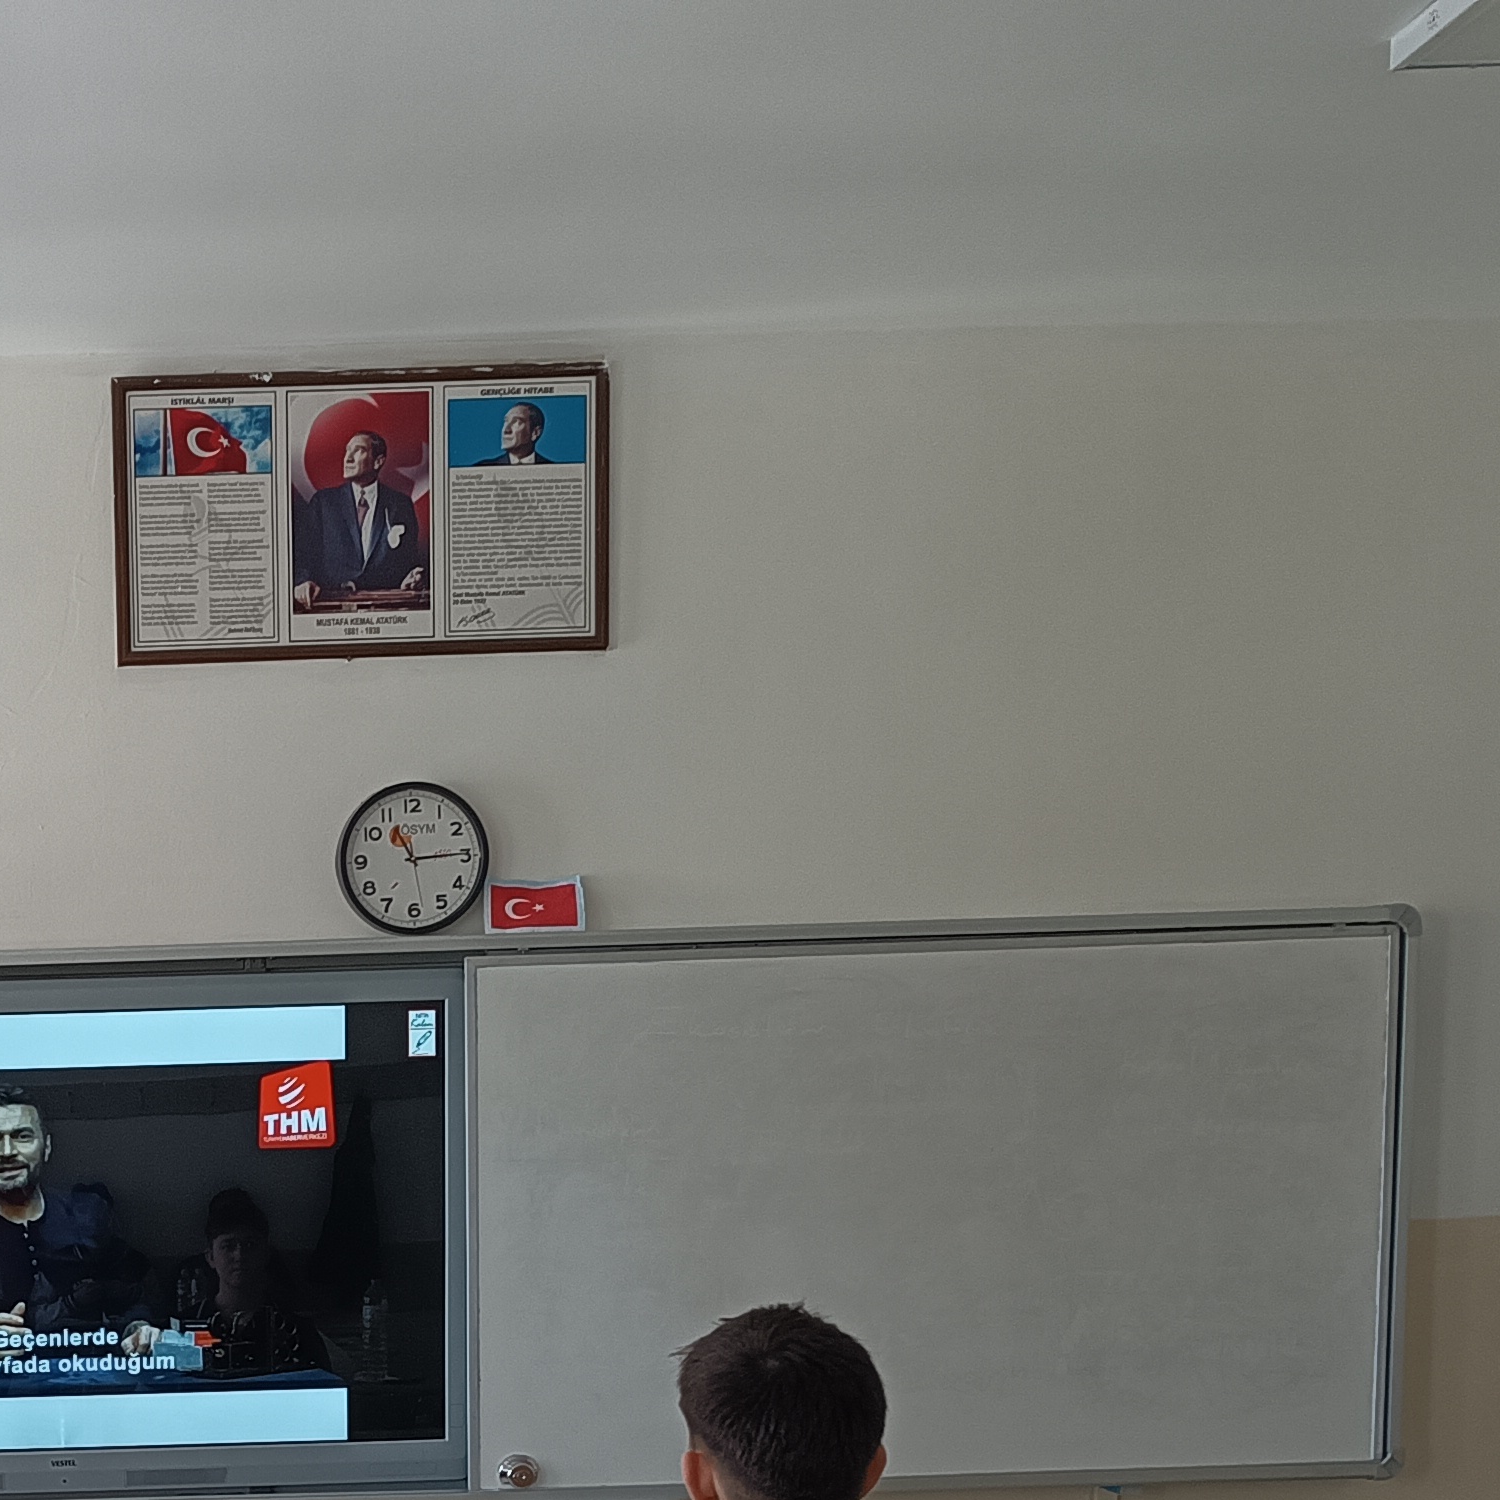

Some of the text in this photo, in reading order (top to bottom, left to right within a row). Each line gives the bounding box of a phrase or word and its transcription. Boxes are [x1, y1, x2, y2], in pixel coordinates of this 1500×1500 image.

[316, 615, 409, 627] MUSTAFA KEMAL ATATÜRK
[403, 798, 422, 814] 12
[437, 805, 441, 820] 1
[381, 807, 393, 823] 11
[364, 826, 383, 842] 10
[401, 823, 436, 835] ÖSYM
[450, 821, 464, 837] 2
[354, 854, 368, 870] 9
[460, 848, 471, 863] 3
[363, 880, 377, 896] 8
[452, 874, 465, 891] 4
[380, 897, 393, 914] 7
[407, 902, 421, 918] 6
[435, 894, 448, 910] 5
[263, 1106, 327, 1136] THM
[58, 1351, 176, 1375] okuduğum
